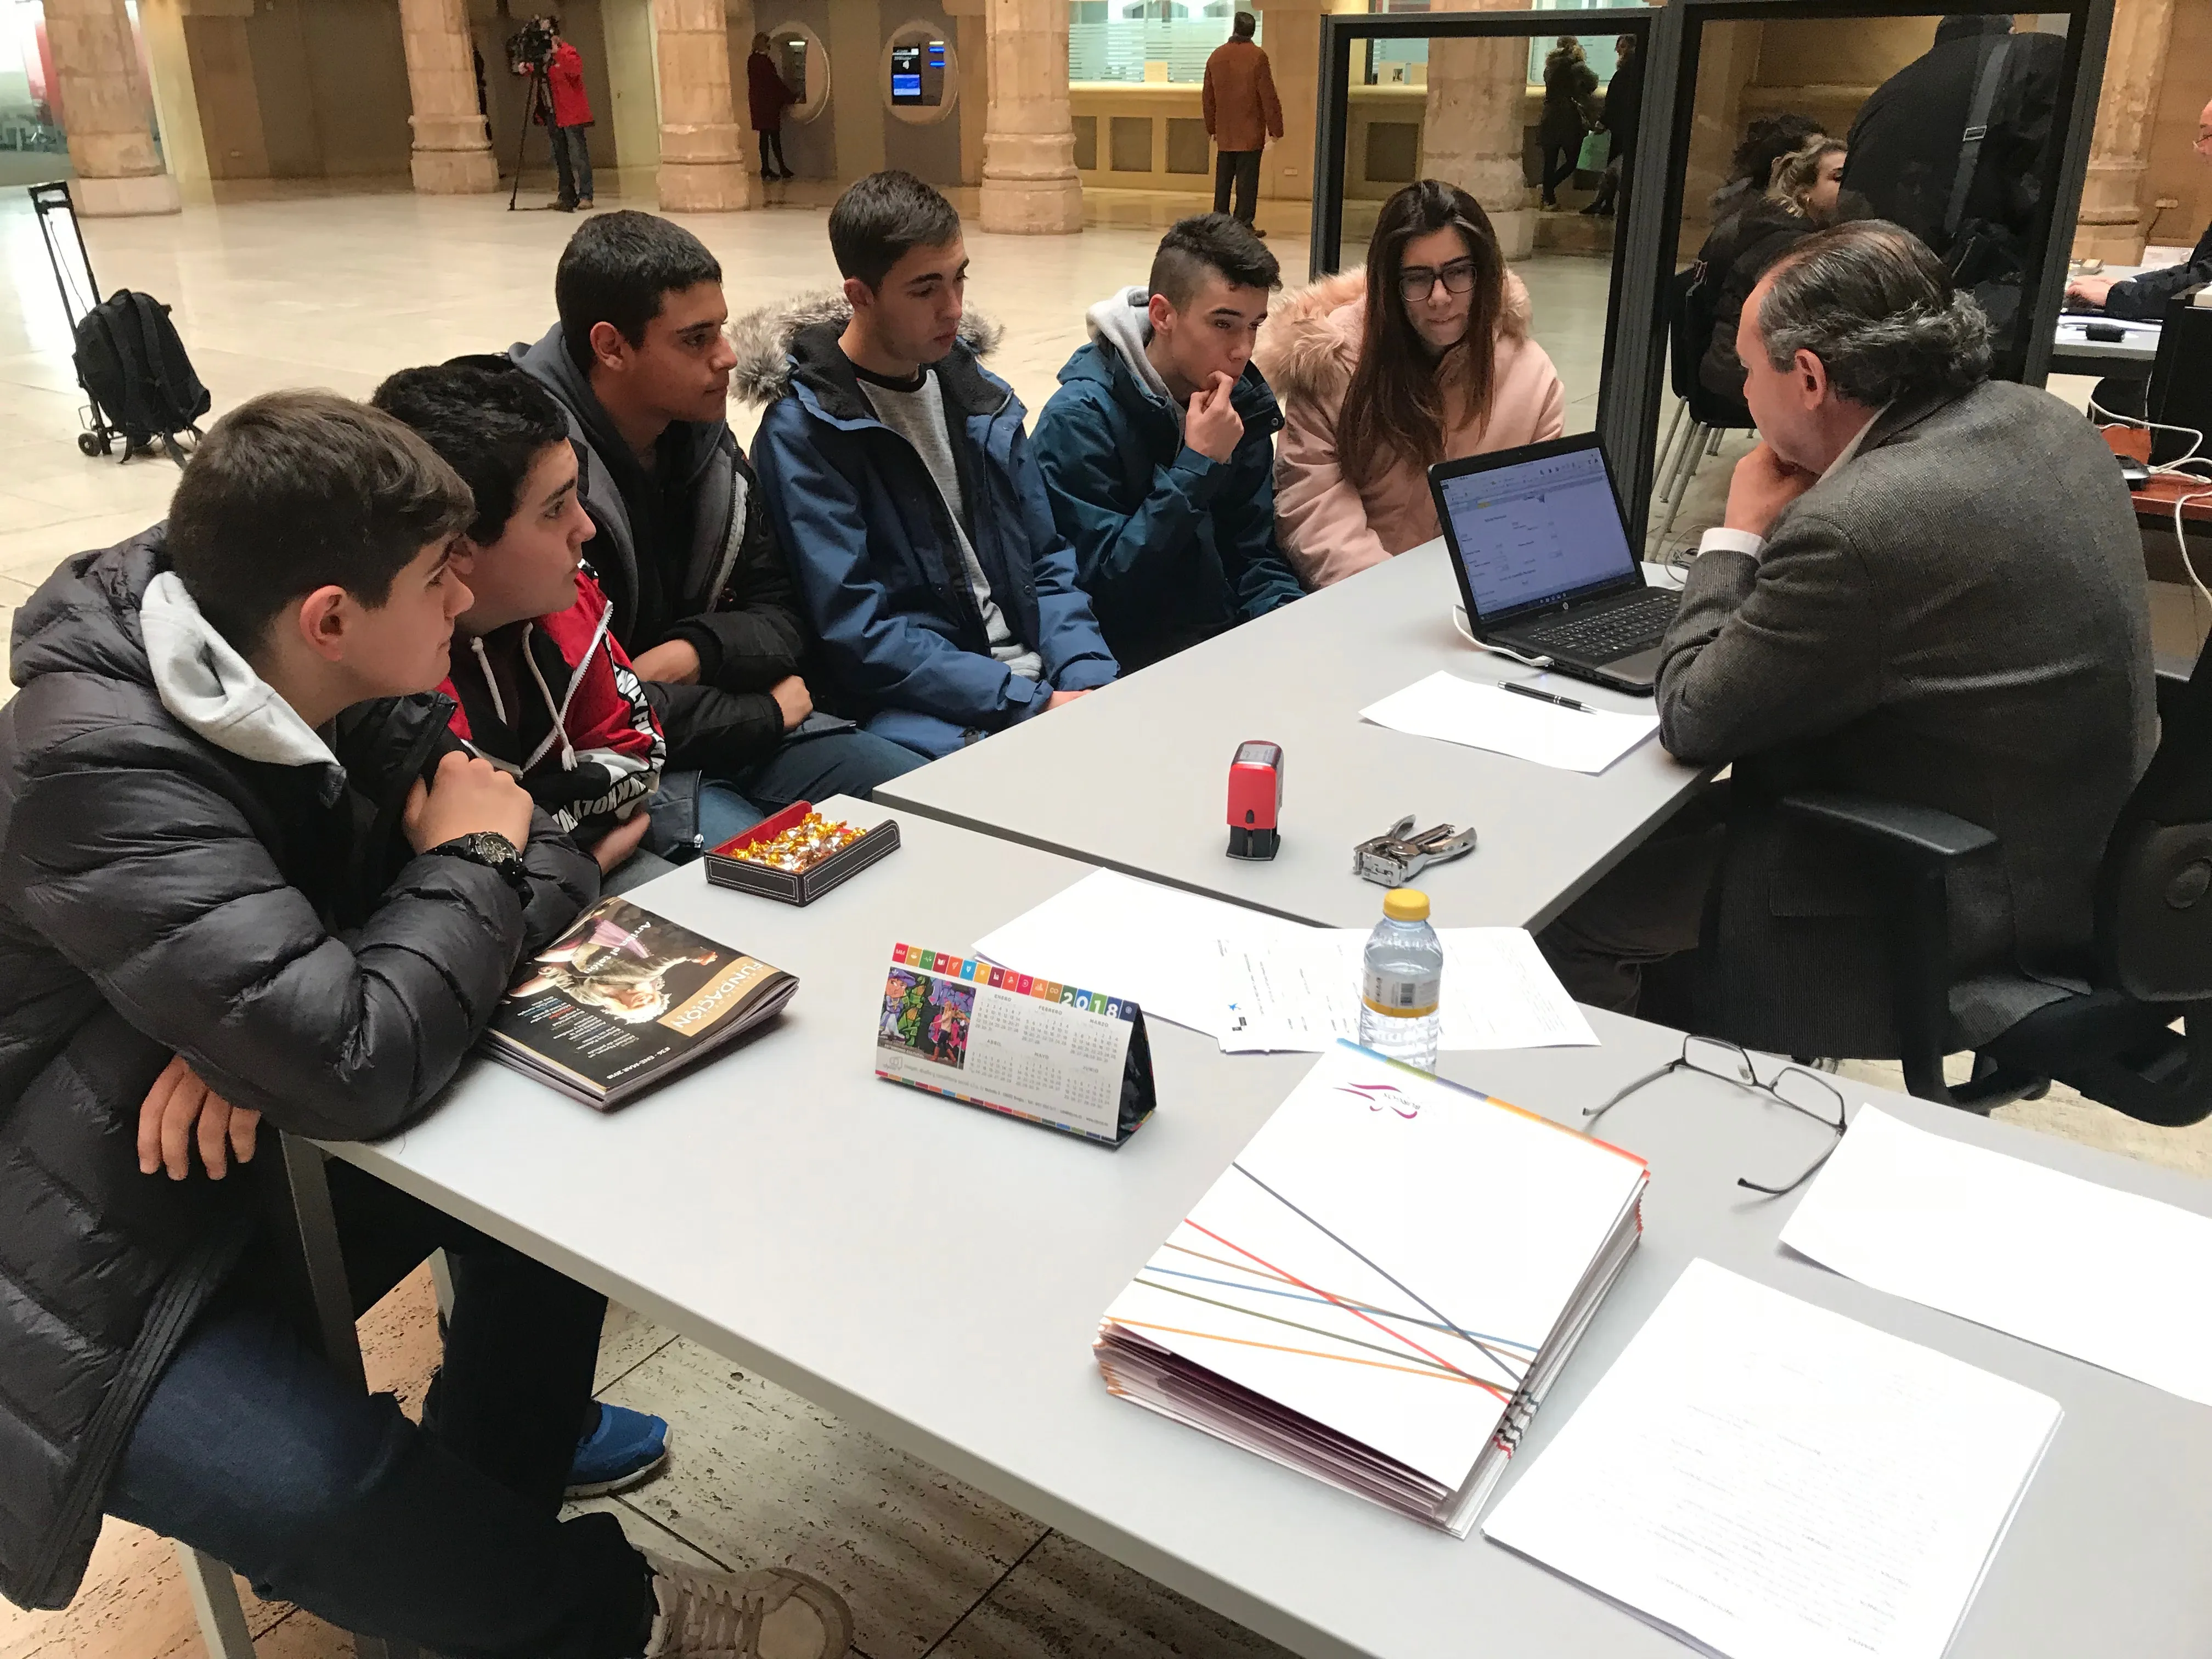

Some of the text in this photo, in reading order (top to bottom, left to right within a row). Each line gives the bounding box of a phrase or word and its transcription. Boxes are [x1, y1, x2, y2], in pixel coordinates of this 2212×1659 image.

[619, 921, 651, 946] Arriba
[610, 947, 620, 956] el
[672, 962, 764, 1028] FUNDACIÓN
[1061, 992, 1118, 1018] 2018
[622, 1055, 655, 1072] ENE-MAR
